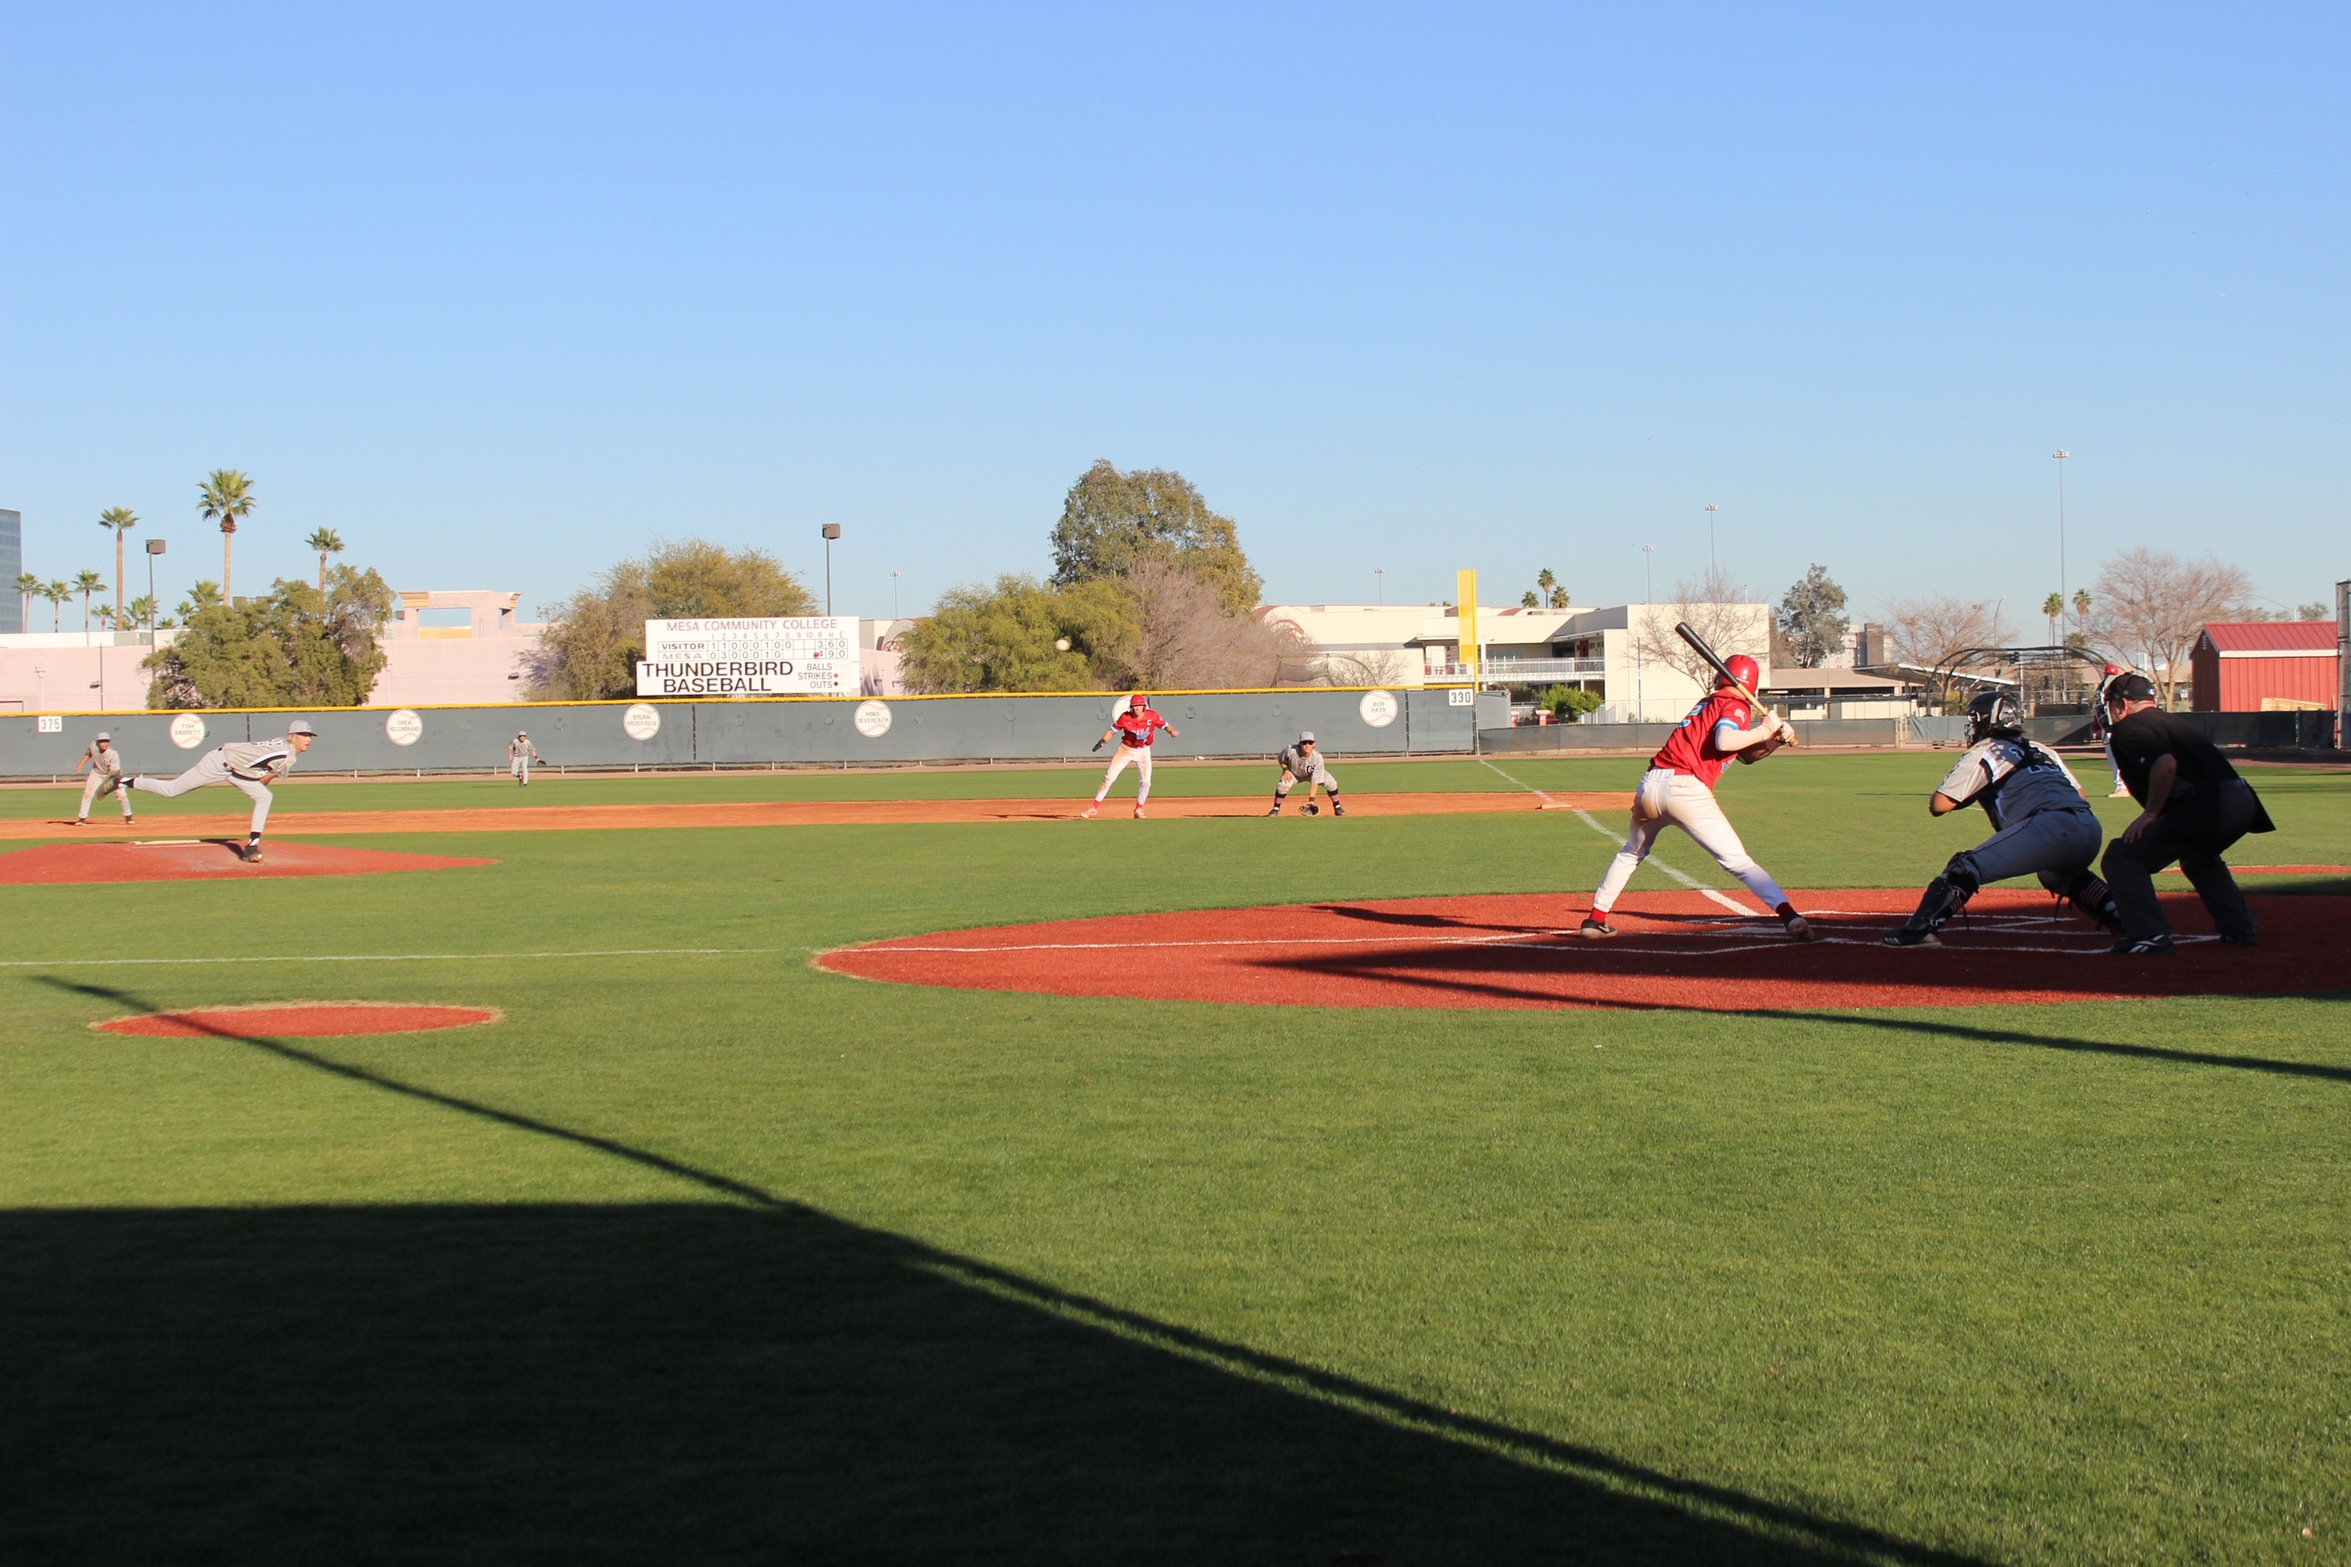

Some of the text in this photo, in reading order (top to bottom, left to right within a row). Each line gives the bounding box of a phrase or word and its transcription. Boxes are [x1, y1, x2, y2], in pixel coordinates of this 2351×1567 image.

[666, 619, 837, 632] MESA COMMUNITY COLLEGE
[732, 642, 738, 650] 0
[742, 642, 748, 650] 0
[753, 642, 759, 650] 0
[774, 641, 780, 649] 0
[785, 640, 791, 648] 0
[828, 640, 834, 648] 6
[710, 652, 716, 660] 0
[722, 652, 727, 660] 3
[732, 652, 738, 660] 0
[742, 651, 748, 659] 0
[753, 651, 759, 659] 0
[774, 650, 780, 658] 0
[828, 650, 834, 658] 9
[839, 649, 845, 657] 0
[642, 661, 794, 678] THUNDERBIRD
[806, 662, 832, 671] BALLS
[798, 672, 832, 680] STRIKES
[664, 678, 772, 693] BASEBALL
[810, 680, 832, 689] OUTS
[1451, 692, 1471, 703] 330
[41, 718, 60, 730] 375
